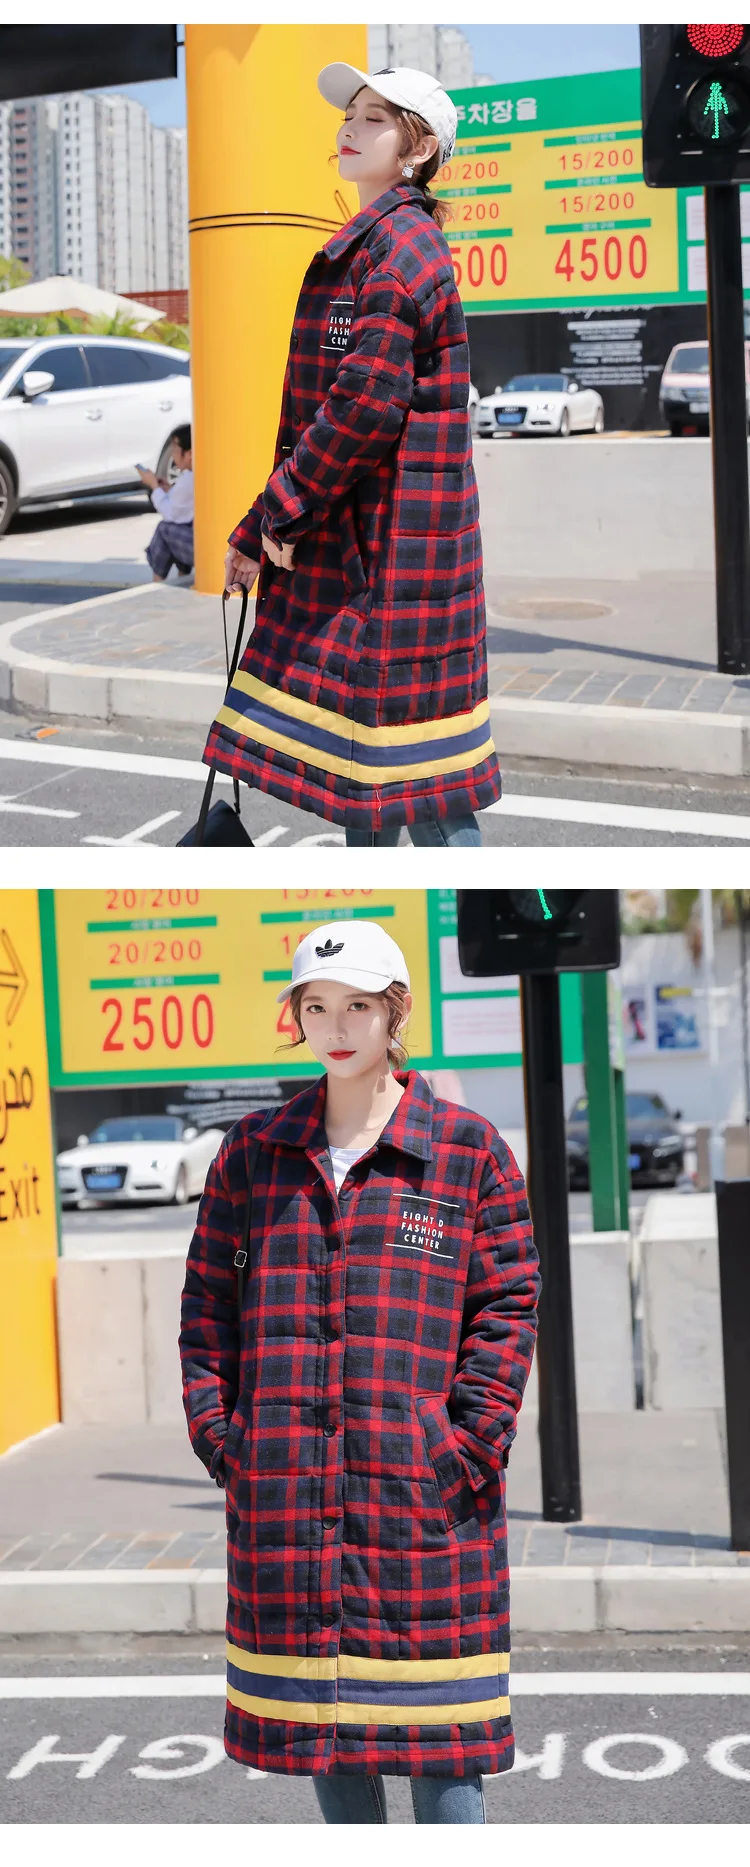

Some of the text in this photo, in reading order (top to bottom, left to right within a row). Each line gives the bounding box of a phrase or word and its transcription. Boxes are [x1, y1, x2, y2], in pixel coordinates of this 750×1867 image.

[559, 148, 634, 171] 15/200
[560, 192, 635, 214] 15/200
[555, 235, 648, 282] 4500
[106, 889, 199, 910] 20/200
[108, 939, 202, 965] 20/200
[101, 994, 214, 1052] 2500
[401, 1222, 443, 1239] FASHION
[403, 1211, 444, 1228] EIGHT D
[404, 1234, 440, 1249] CENTER
